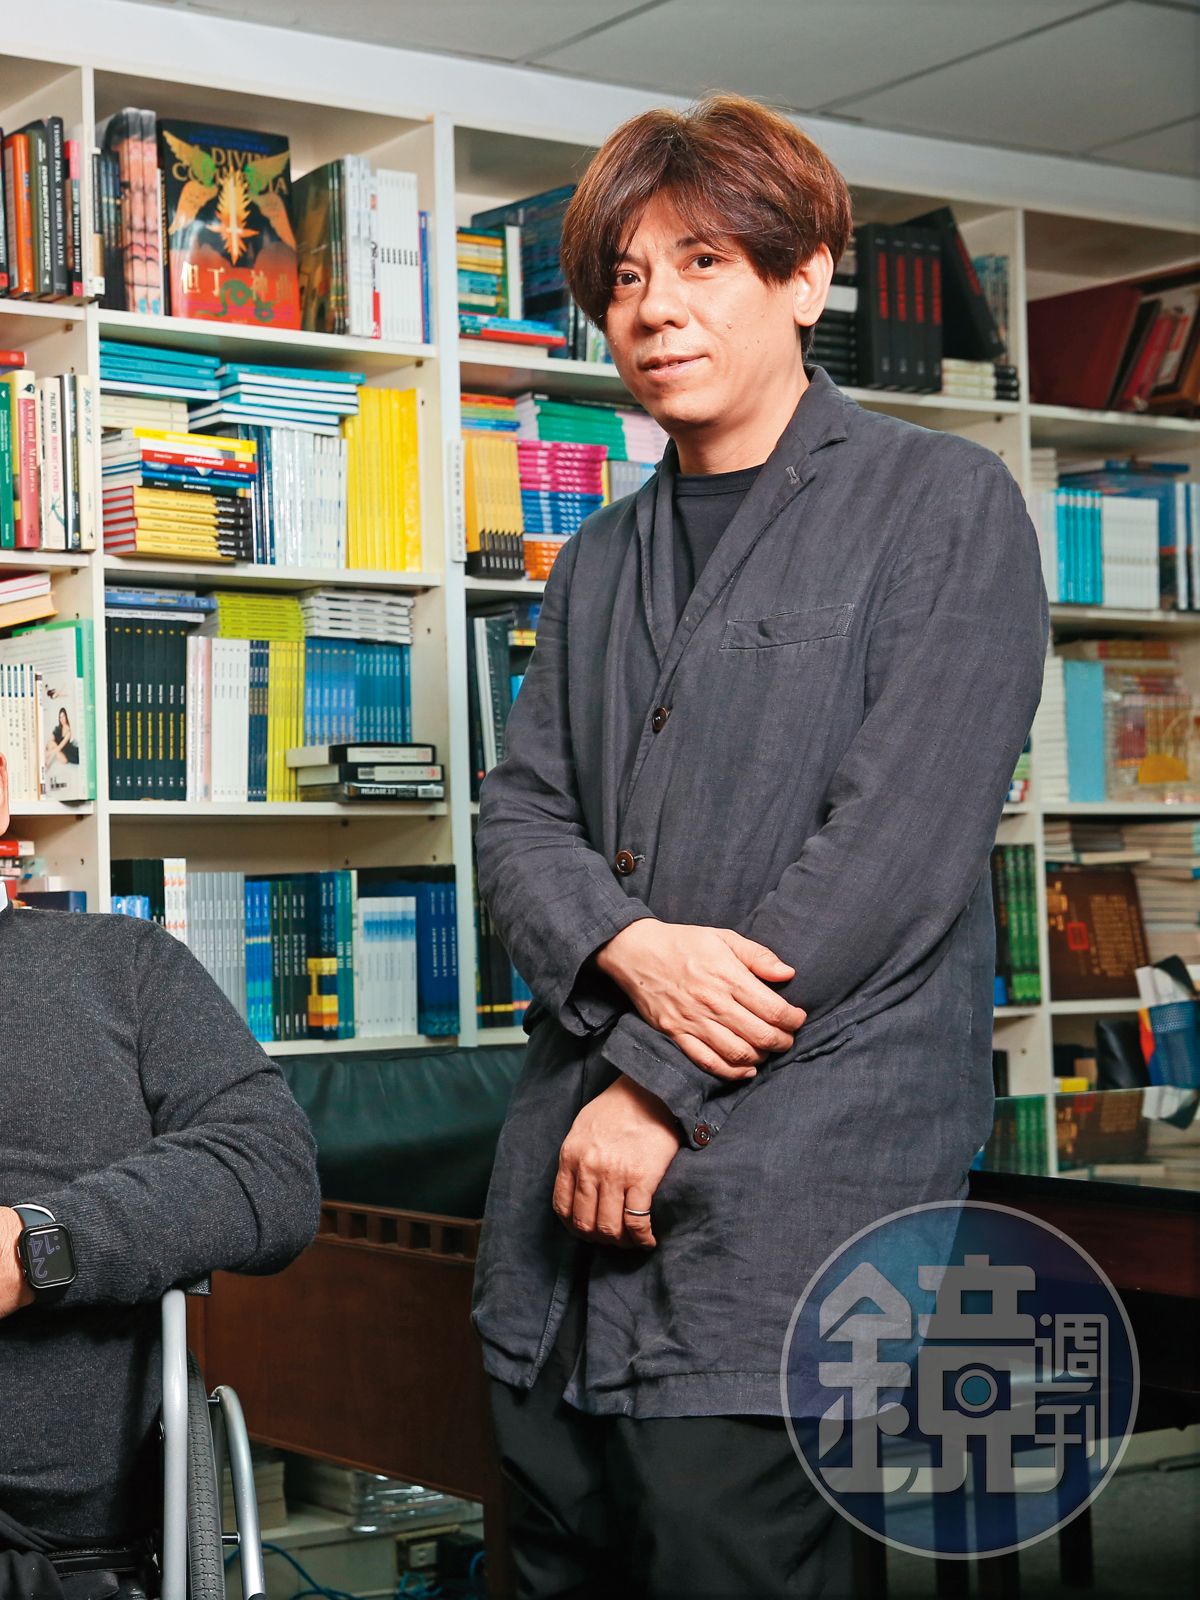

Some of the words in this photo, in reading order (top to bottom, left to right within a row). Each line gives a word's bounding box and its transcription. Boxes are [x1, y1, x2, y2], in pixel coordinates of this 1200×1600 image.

[40, 165, 49, 185] EVEN
[54, 160, 63, 183] PARK
[41, 186, 50, 217] BUFFETT
[54, 187, 63, 198] IN
[54, 200, 64, 230] ORDER
[56, 232, 64, 244] TO
[43, 238, 52, 271] PERFECT
[56, 245, 65, 266] LIVE
[27, 402, 37, 442] Animal
[28, 448, 38, 493] Madness
